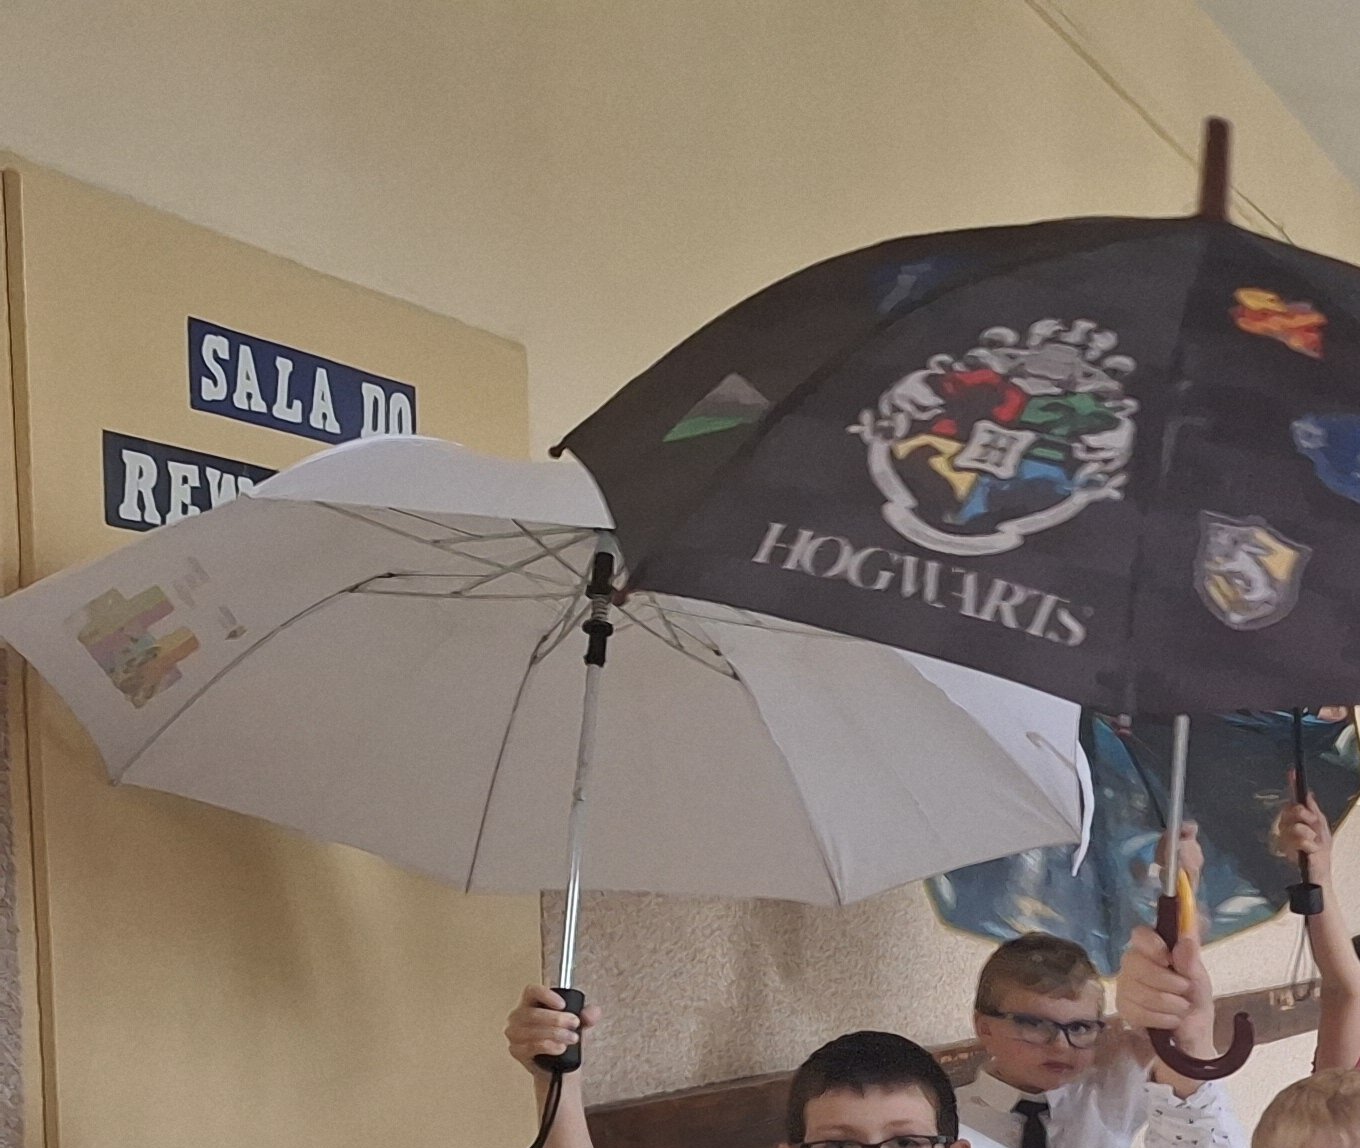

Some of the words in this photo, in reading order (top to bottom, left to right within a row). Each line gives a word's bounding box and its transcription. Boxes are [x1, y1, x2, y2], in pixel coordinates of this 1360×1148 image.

[200, 333, 342, 434] SALA
[361, 381, 413, 438] DO
[751, 521, 1088, 648] HOGWARTS
